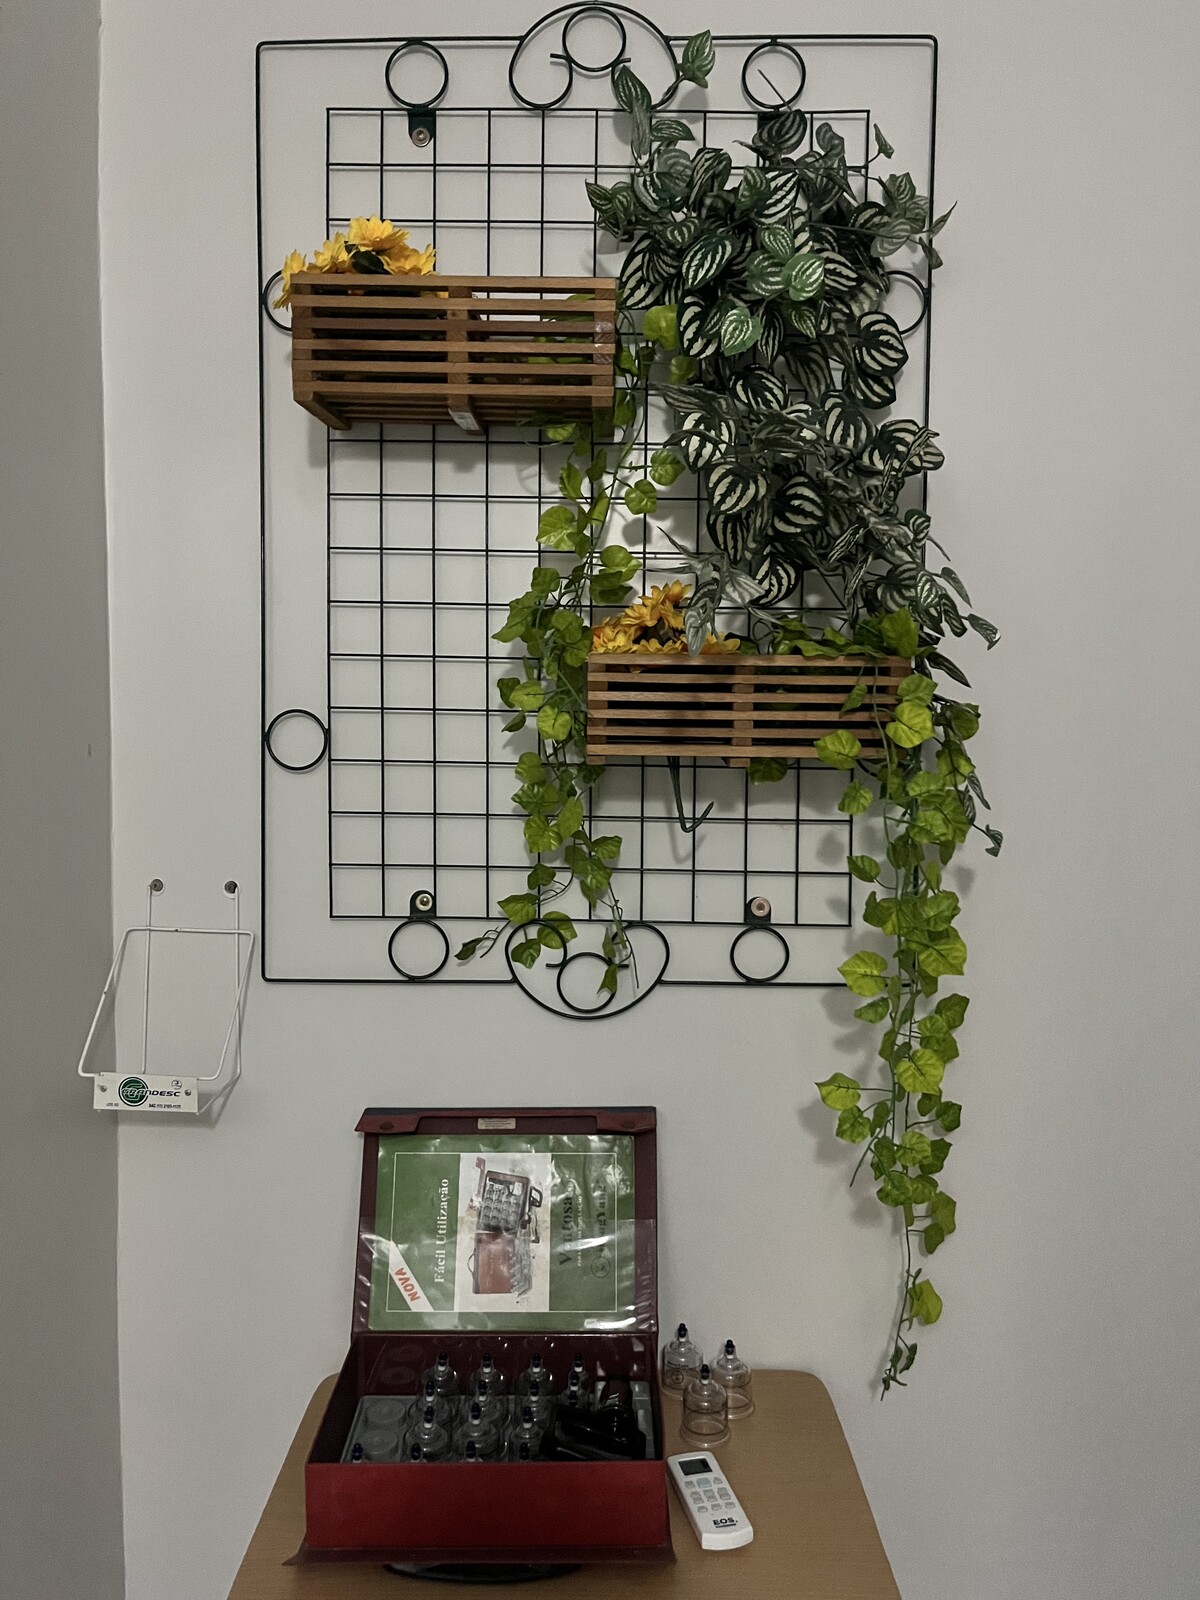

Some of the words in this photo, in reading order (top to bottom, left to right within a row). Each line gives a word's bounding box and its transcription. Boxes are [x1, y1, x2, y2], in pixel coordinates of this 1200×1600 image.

[435, 1179, 451, 1245] Utilização
[434, 1250, 446, 1283] Fácil
[395, 1267, 421, 1302] NOVA
